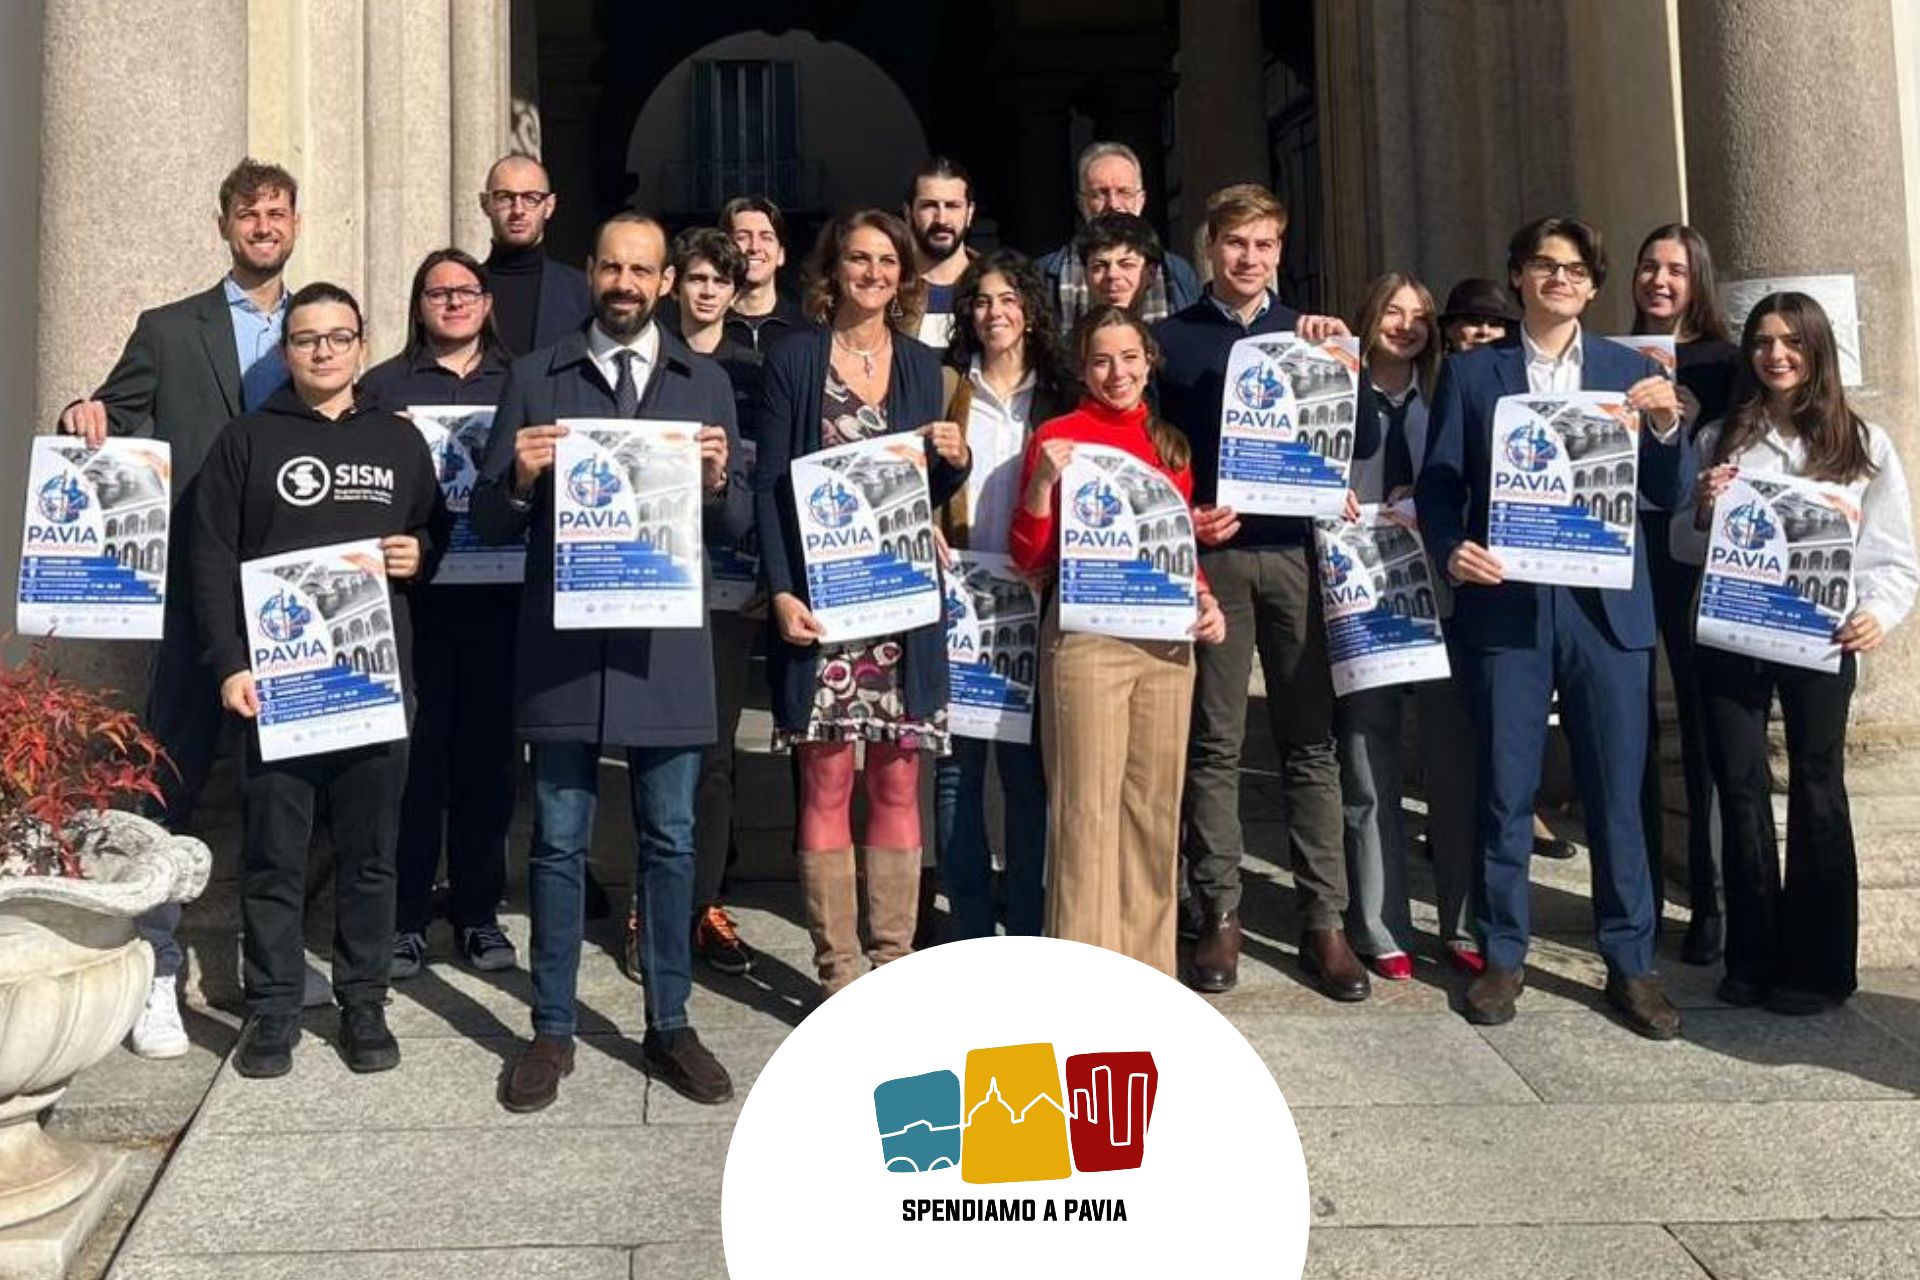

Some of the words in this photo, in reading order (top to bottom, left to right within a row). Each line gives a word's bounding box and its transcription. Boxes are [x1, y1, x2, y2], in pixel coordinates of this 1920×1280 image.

[1226, 409, 1291, 429] PAVIA
[335, 463, 394, 490] SISM
[1495, 472, 1566, 493] PAVIA
[559, 510, 632, 528] PAVIA
[28, 525, 98, 543] PAVIA
[806, 526, 873, 551] PAVIA
[1065, 529, 1133, 547] PAVIA
[1712, 546, 1781, 572] PAVIA
[255, 638, 327, 665] PAVIA
